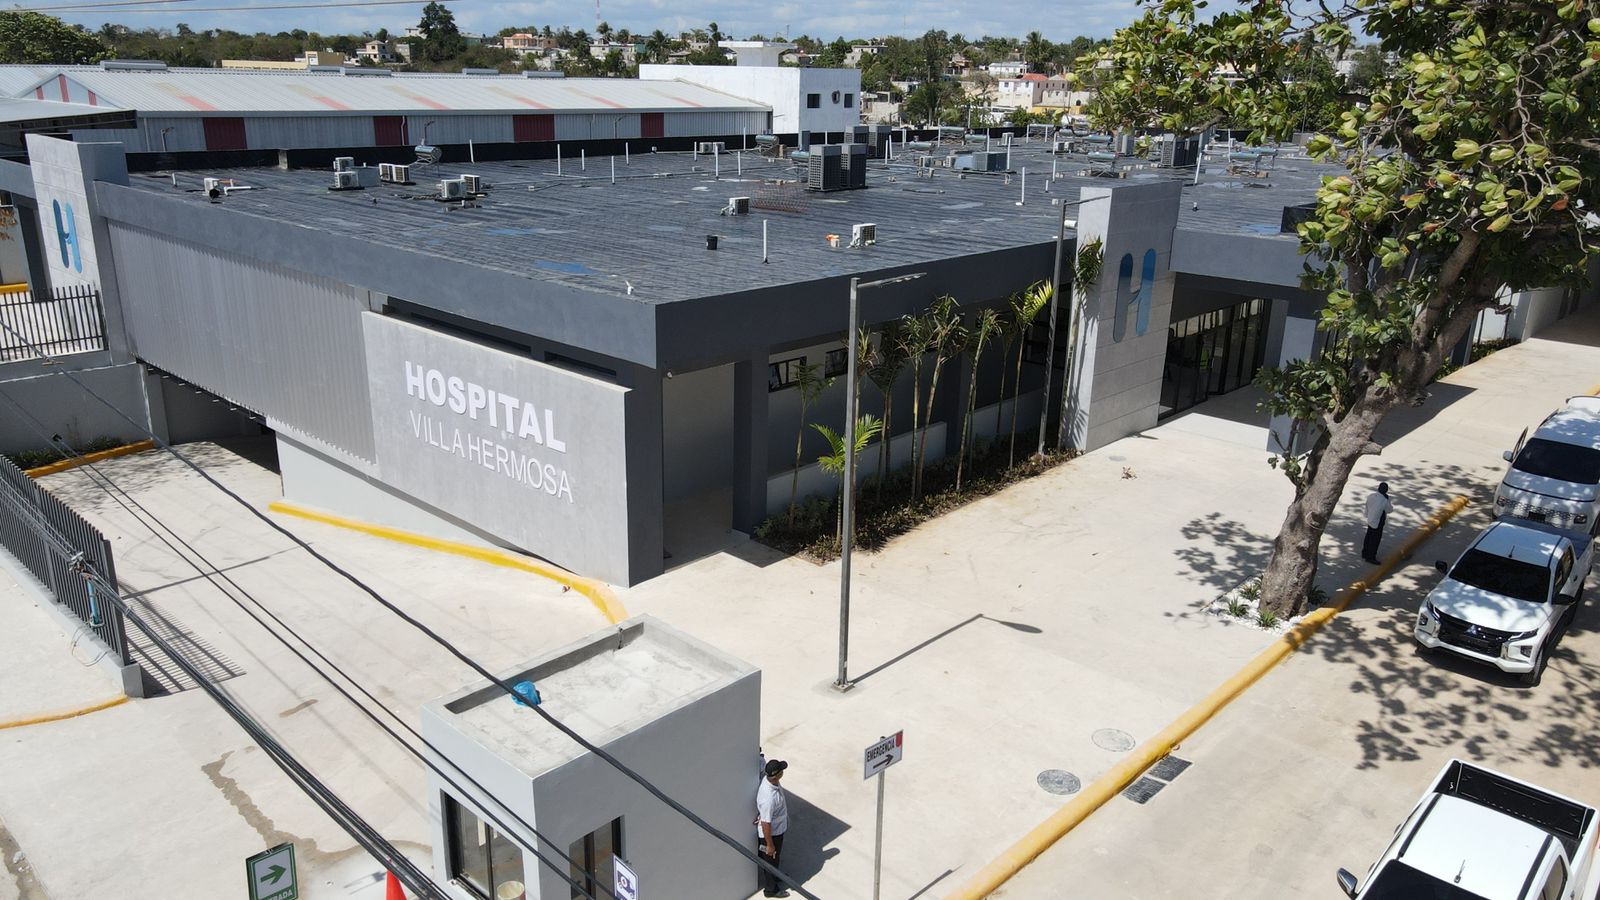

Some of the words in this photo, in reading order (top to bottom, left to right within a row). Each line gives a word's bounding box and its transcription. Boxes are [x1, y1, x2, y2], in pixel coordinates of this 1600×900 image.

[405, 360, 567, 453] HOSPITAL
[410, 409, 465, 459] VILLA
[468, 433, 574, 504] HERMOSA
[867, 738, 895, 762] EMERGENCIA
